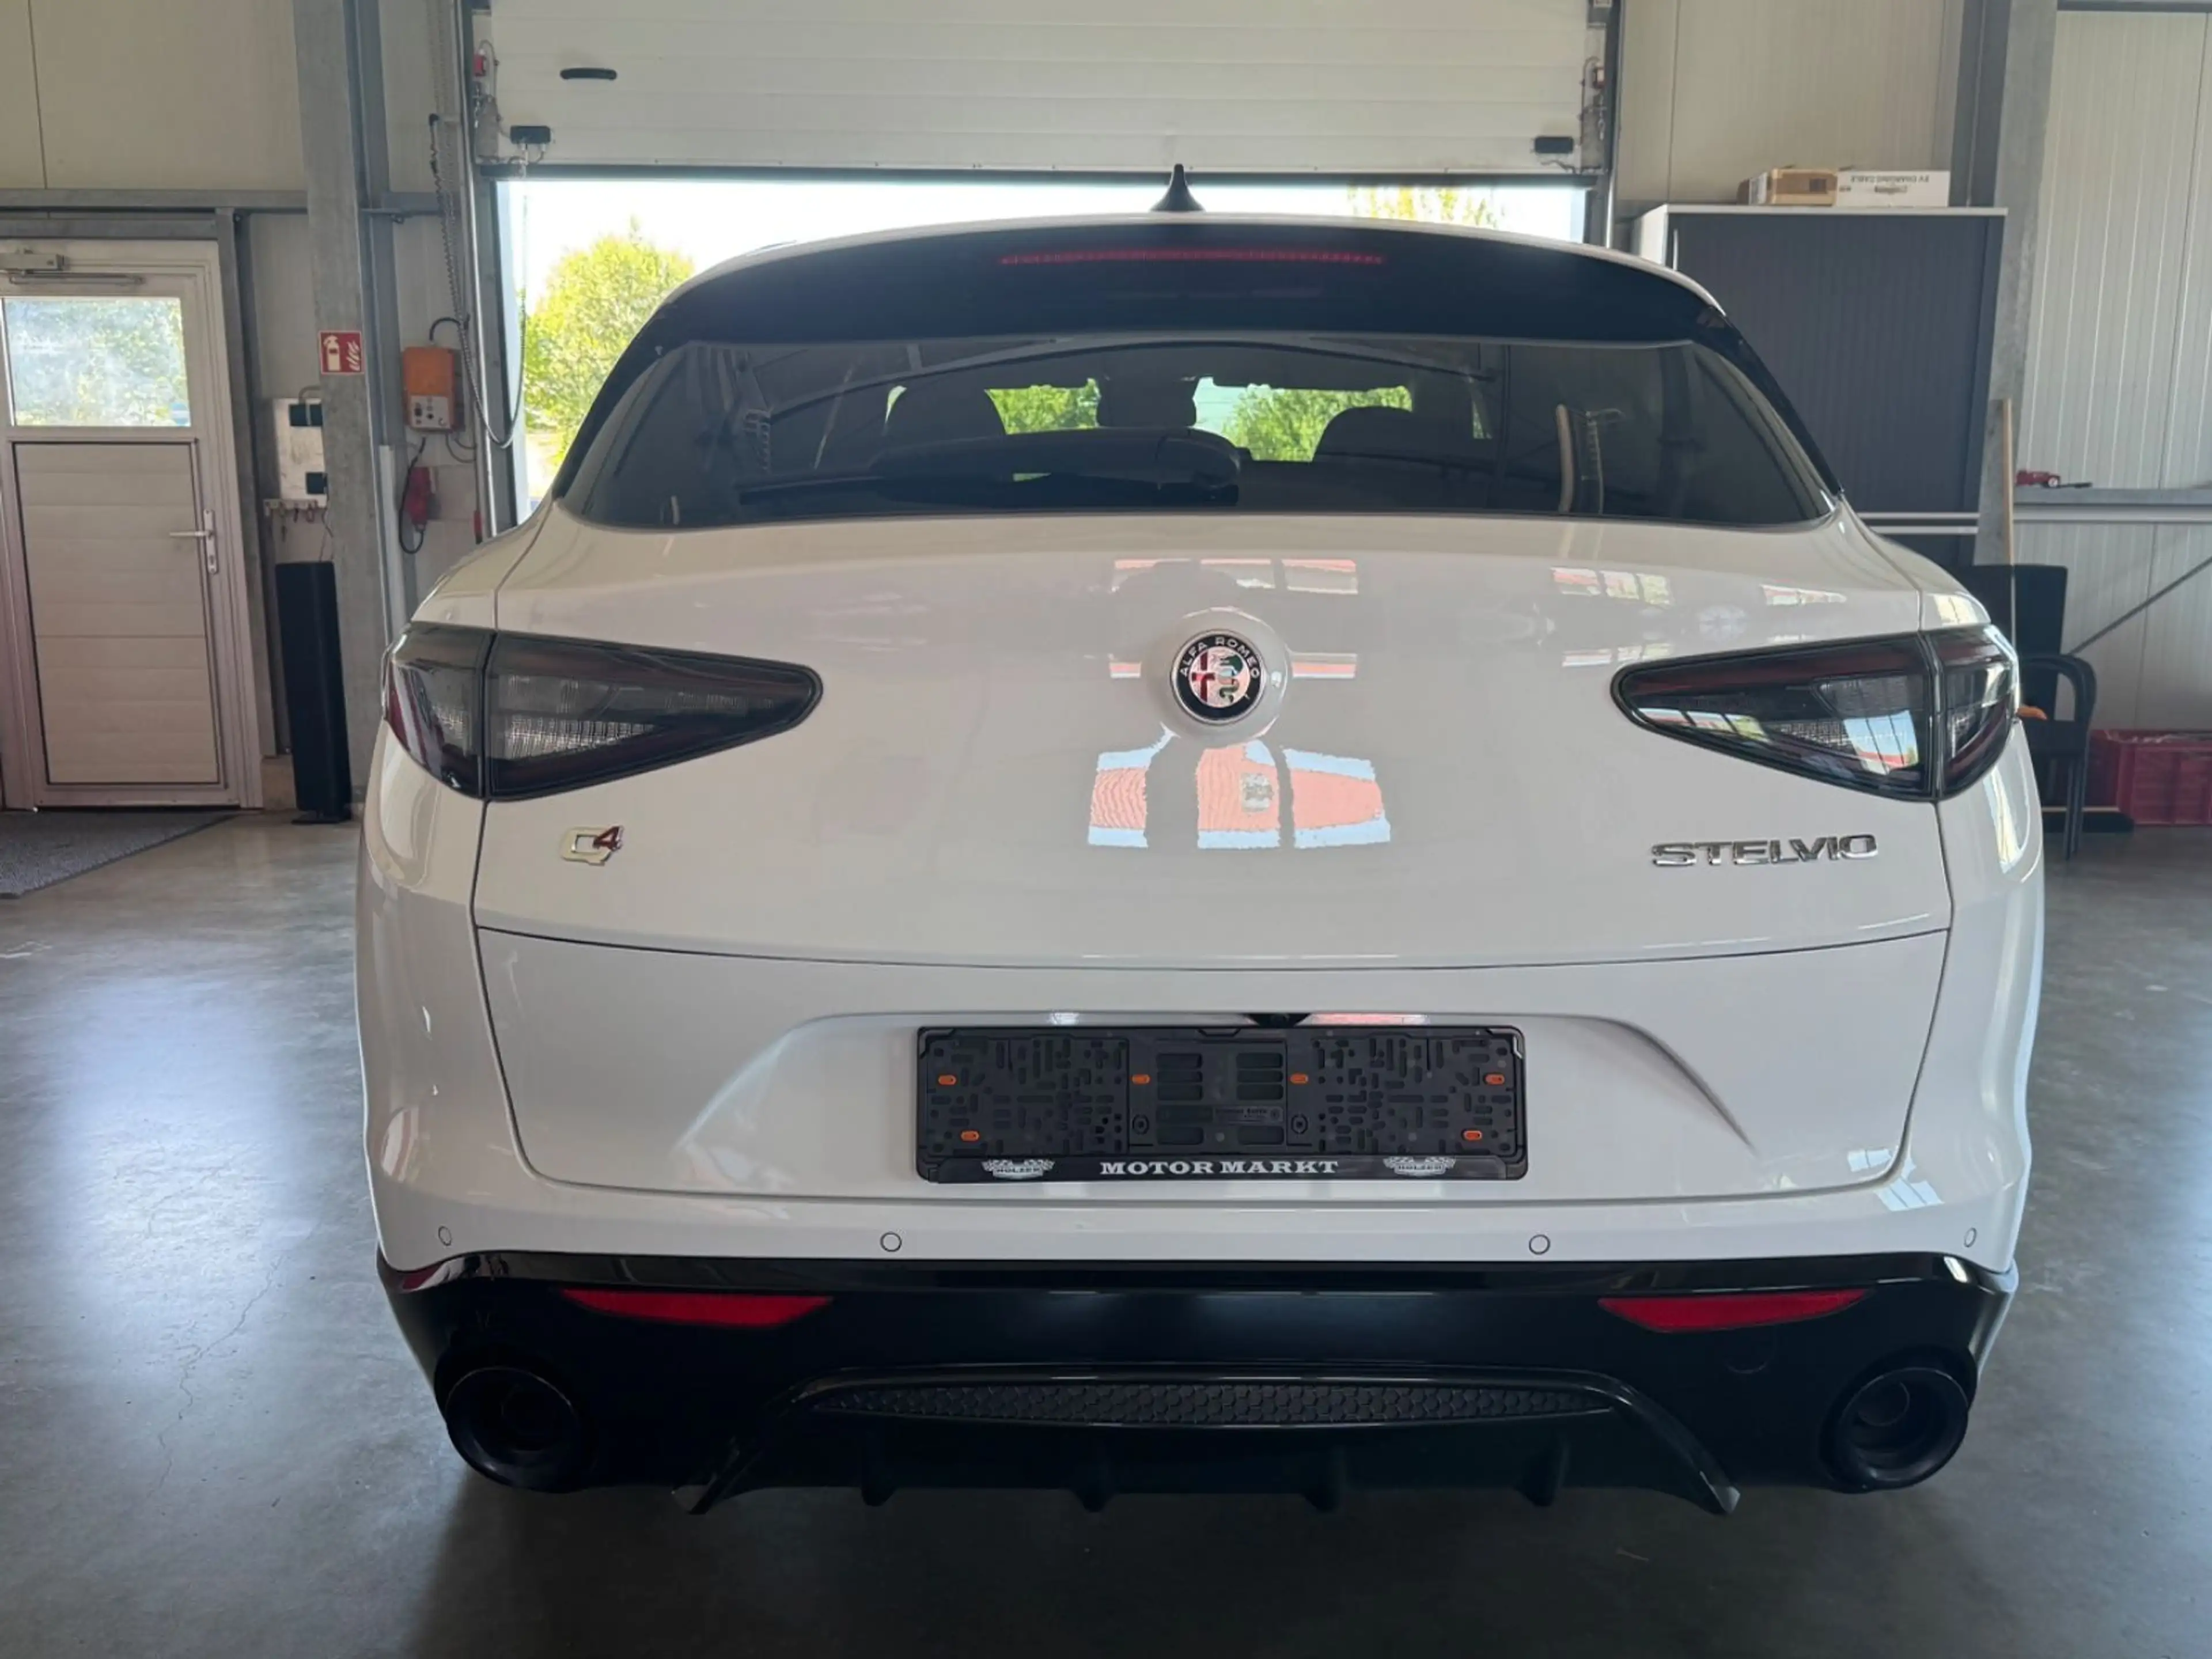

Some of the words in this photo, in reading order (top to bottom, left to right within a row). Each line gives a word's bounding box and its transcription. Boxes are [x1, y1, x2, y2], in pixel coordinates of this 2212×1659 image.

[1180, 641, 1208, 677] ALFA
[1214, 636, 1260, 679] ROMEO
[1651, 834, 1878, 867] STELVIO
[1100, 1161, 1214, 1175] MOTOR
[1220, 1160, 1339, 1174] MARKT
